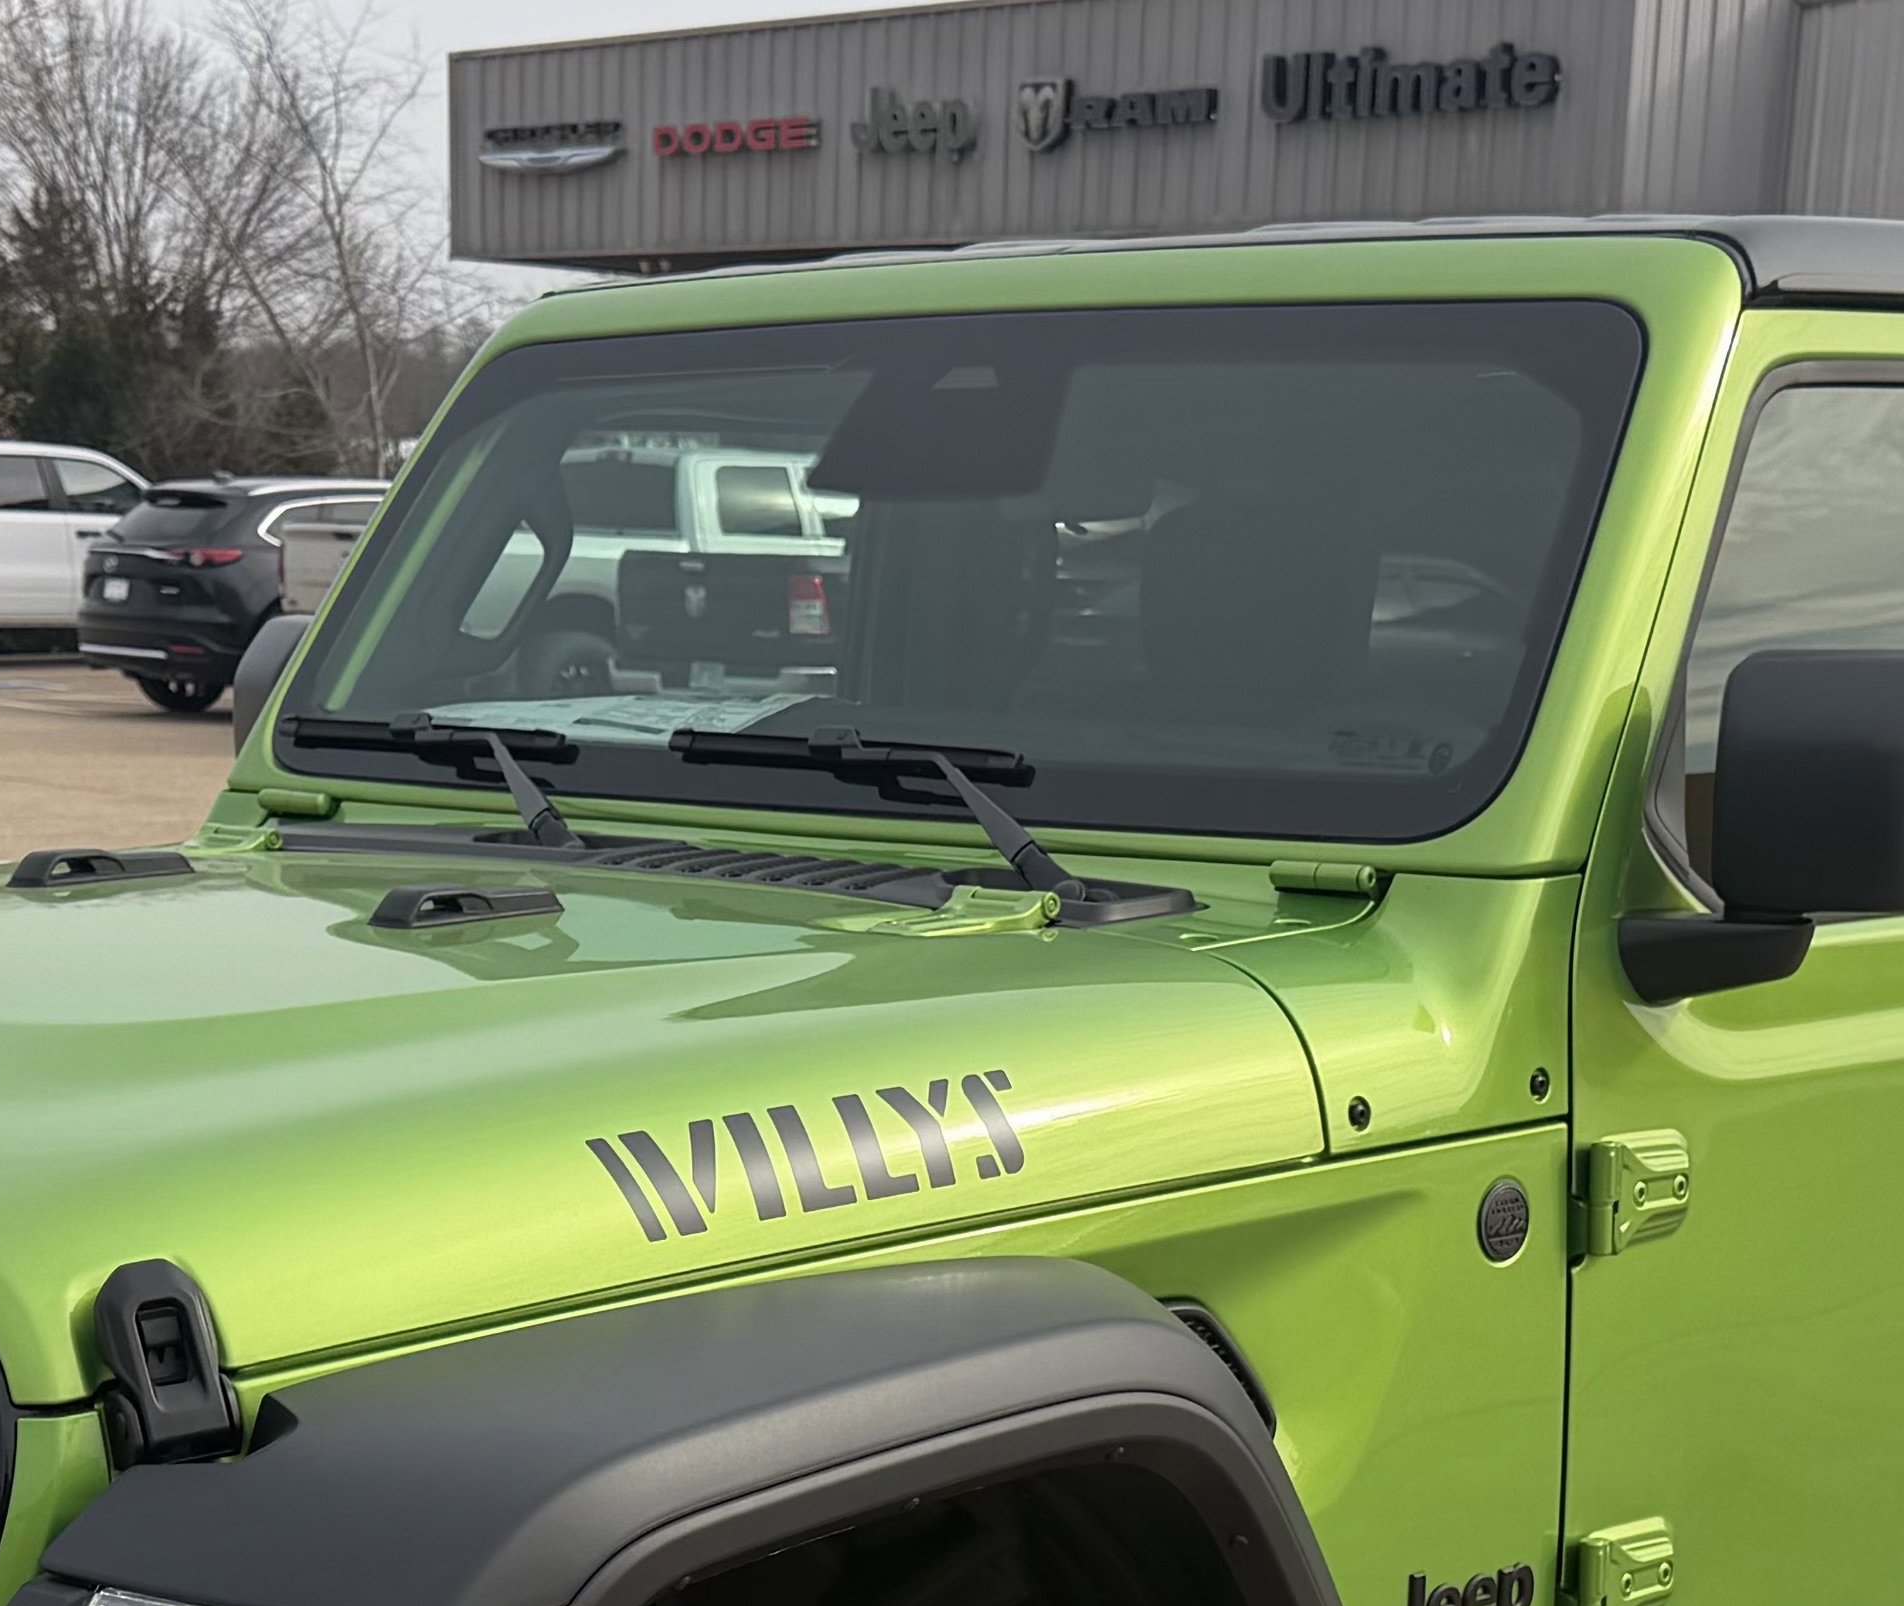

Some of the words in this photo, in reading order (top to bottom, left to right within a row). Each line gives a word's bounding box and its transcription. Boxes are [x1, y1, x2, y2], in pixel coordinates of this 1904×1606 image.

[1069, 88, 1219, 130] RAM
[1262, 42, 1561, 124] Ultimate
[652, 117, 819, 156] DODGE
[853, 86, 978, 161] Jeep
[584, 1069, 1025, 1242] WILLYS
